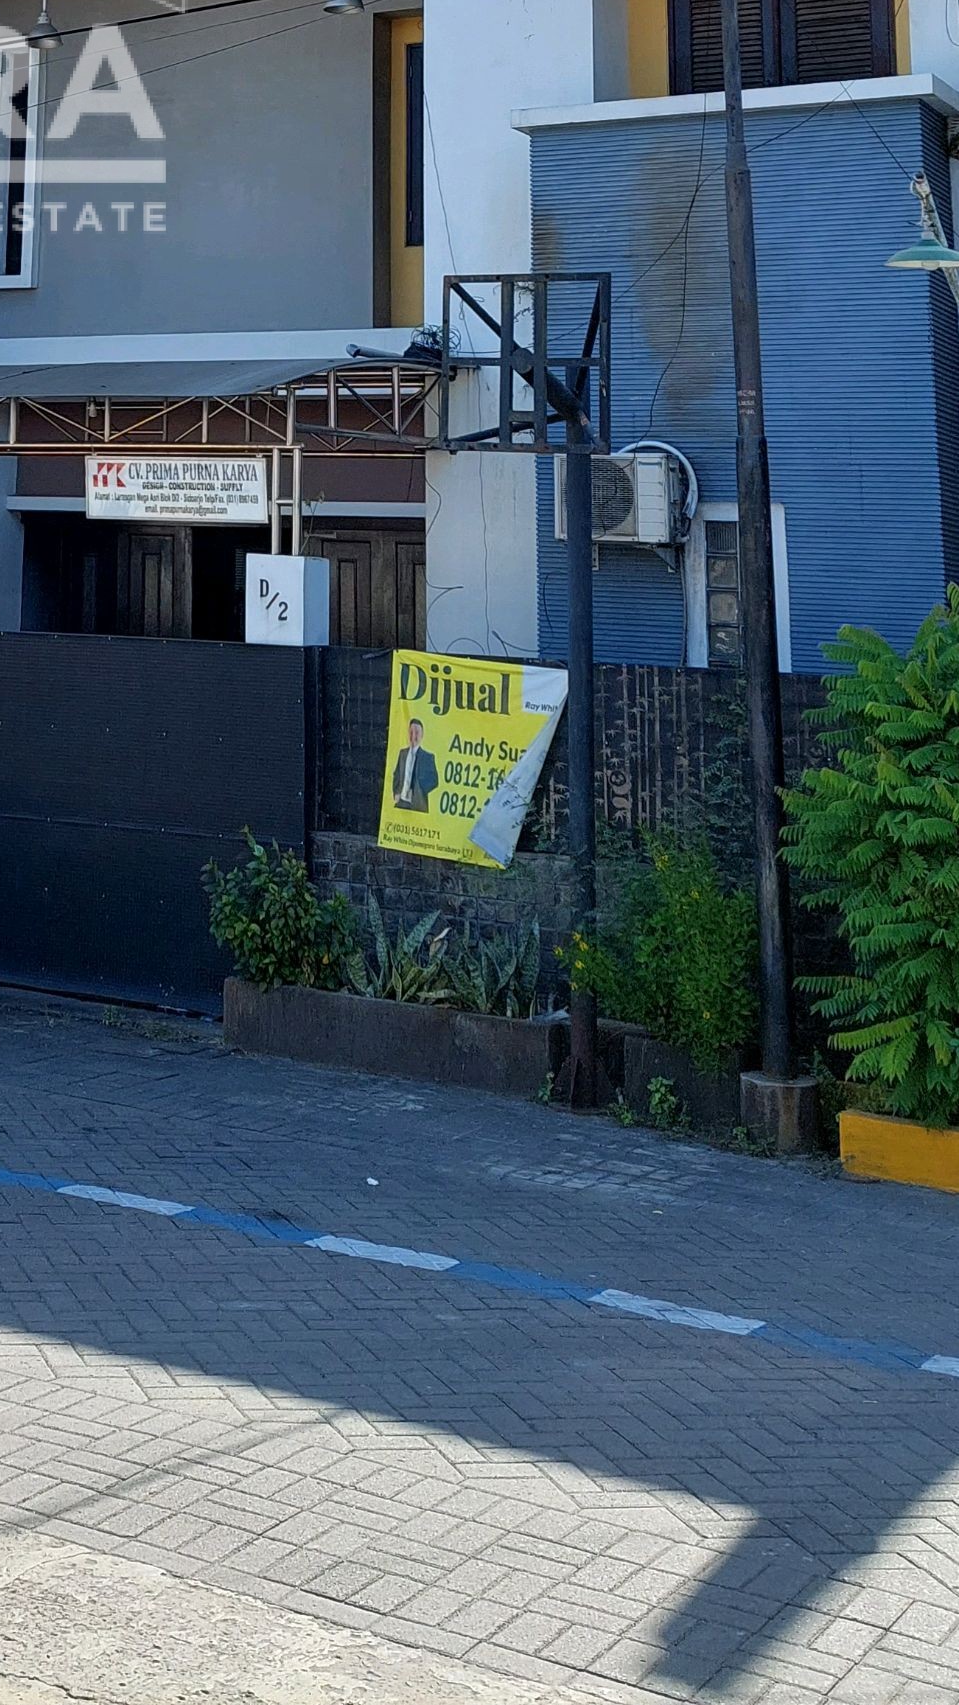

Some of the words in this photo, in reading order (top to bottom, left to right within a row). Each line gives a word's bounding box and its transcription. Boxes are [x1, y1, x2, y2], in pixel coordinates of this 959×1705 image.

[128, 462, 143, 480] CV.
[145, 462, 180, 481] PRIMA
[182, 463, 220, 481] PURNA
[222, 463, 258, 482] KARYA
[142, 482, 164, 490] DESIGN
[168, 482, 216, 491] CONSTRUCTION
[220, 483, 244, 492] SUPPLY
[259, 578, 289, 621] D/2
[398, 663, 511, 716] Dijual
[524, 701, 540, 712] Ray
[449, 734, 494, 762] Andy
[439, 791, 490, 819] 0812-
